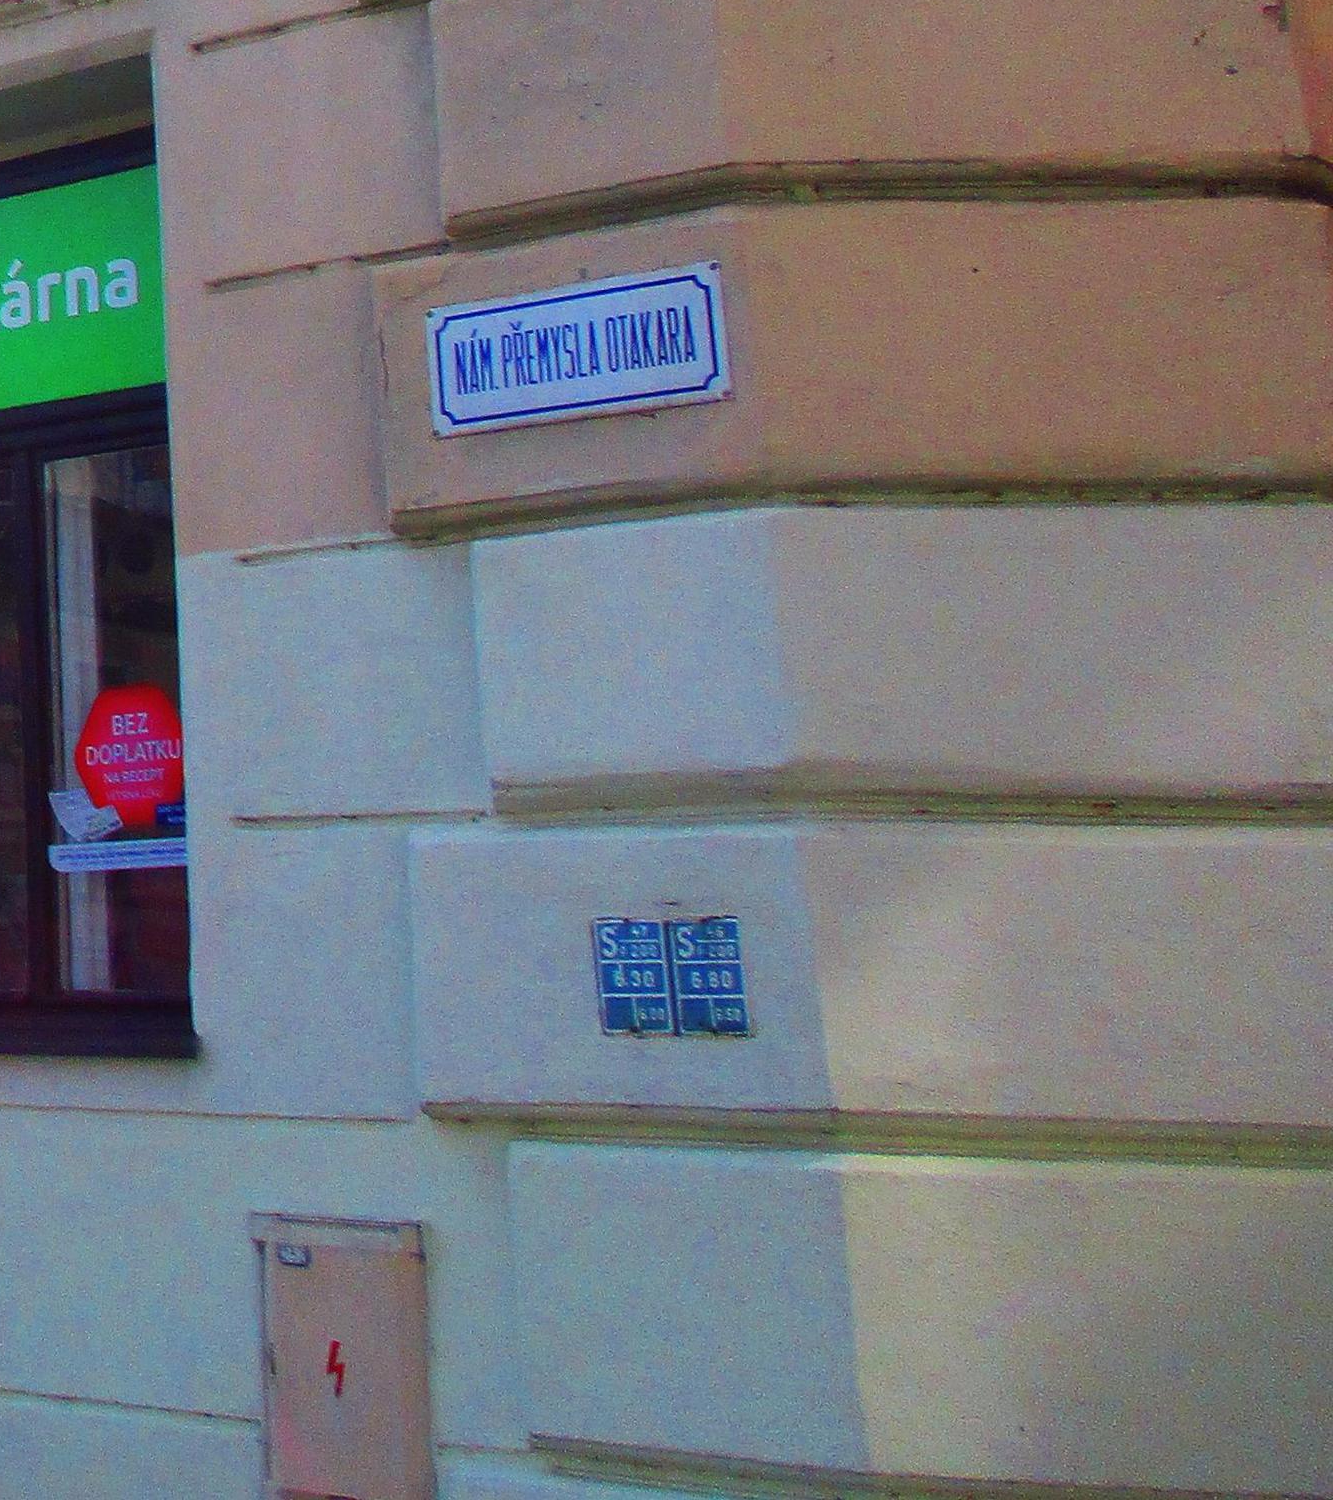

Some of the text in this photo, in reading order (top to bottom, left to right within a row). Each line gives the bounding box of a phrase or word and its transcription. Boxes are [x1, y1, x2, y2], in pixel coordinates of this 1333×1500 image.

[454, 305, 697, 396] NÁM. PŘEMYSLA OTAKARA
[112, 712, 149, 736] BEZ
[85, 738, 182, 766] DOPLATKU
[600, 926, 618, 958] S
[677, 926, 694, 958] S
